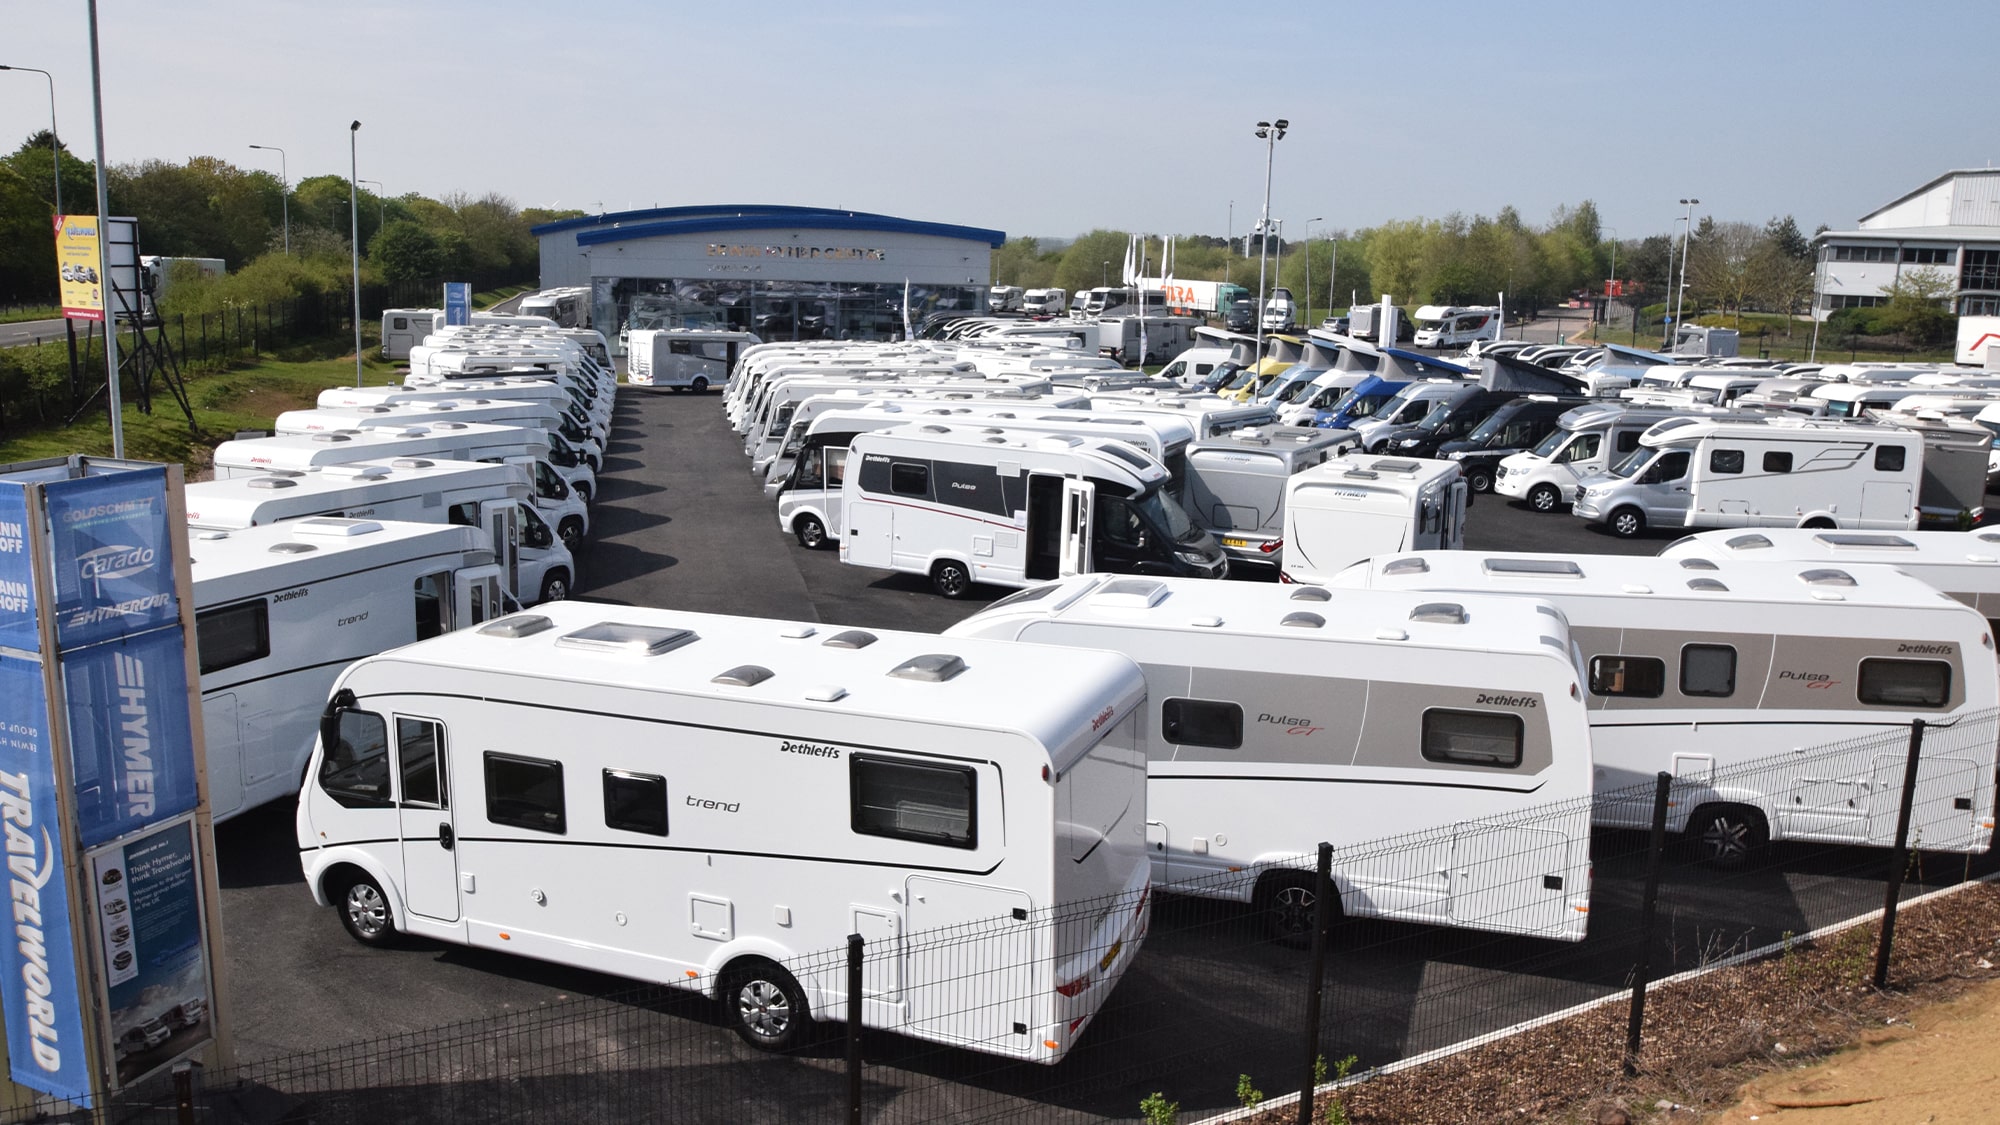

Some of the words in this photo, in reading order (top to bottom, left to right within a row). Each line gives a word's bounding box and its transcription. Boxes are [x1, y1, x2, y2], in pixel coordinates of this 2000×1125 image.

[706, 243, 761, 257] ERWIN
[766, 245, 820, 258] HYMER
[824, 247, 885, 261] CENTRE
[63, 497, 155, 522] GOLDSCHMTT
[348, 509, 375, 518] Dethleffs
[81, 546, 155, 579] Carado
[273, 587, 309, 604] Dethleffs
[82, 592, 170, 625] HYMERCAR
[338, 611, 368, 627] trend
[1897, 643, 1952, 654] Dethleffs
[1778, 670, 1829, 681] Pulse
[1806, 681, 1841, 689] GT
[1476, 693, 1537, 708] Dethleffs
[1092, 705, 1114, 731] Dethleffs
[1257, 713, 1311, 727] Pulse
[9, 724, 38, 738] GROUP
[1286, 726, 1325, 736] GT
[118, 687, 157, 819] HYMER
[781, 741, 840, 758] Dethleffs
[686, 795, 740, 813] trend
[130, 860, 151, 875] Think
[152, 852, 178, 867] Hymer,
[132, 872, 150, 884] think
[151, 853, 192, 876] Travelworld
[0, 768, 61, 1073] TRAVELWORLD
